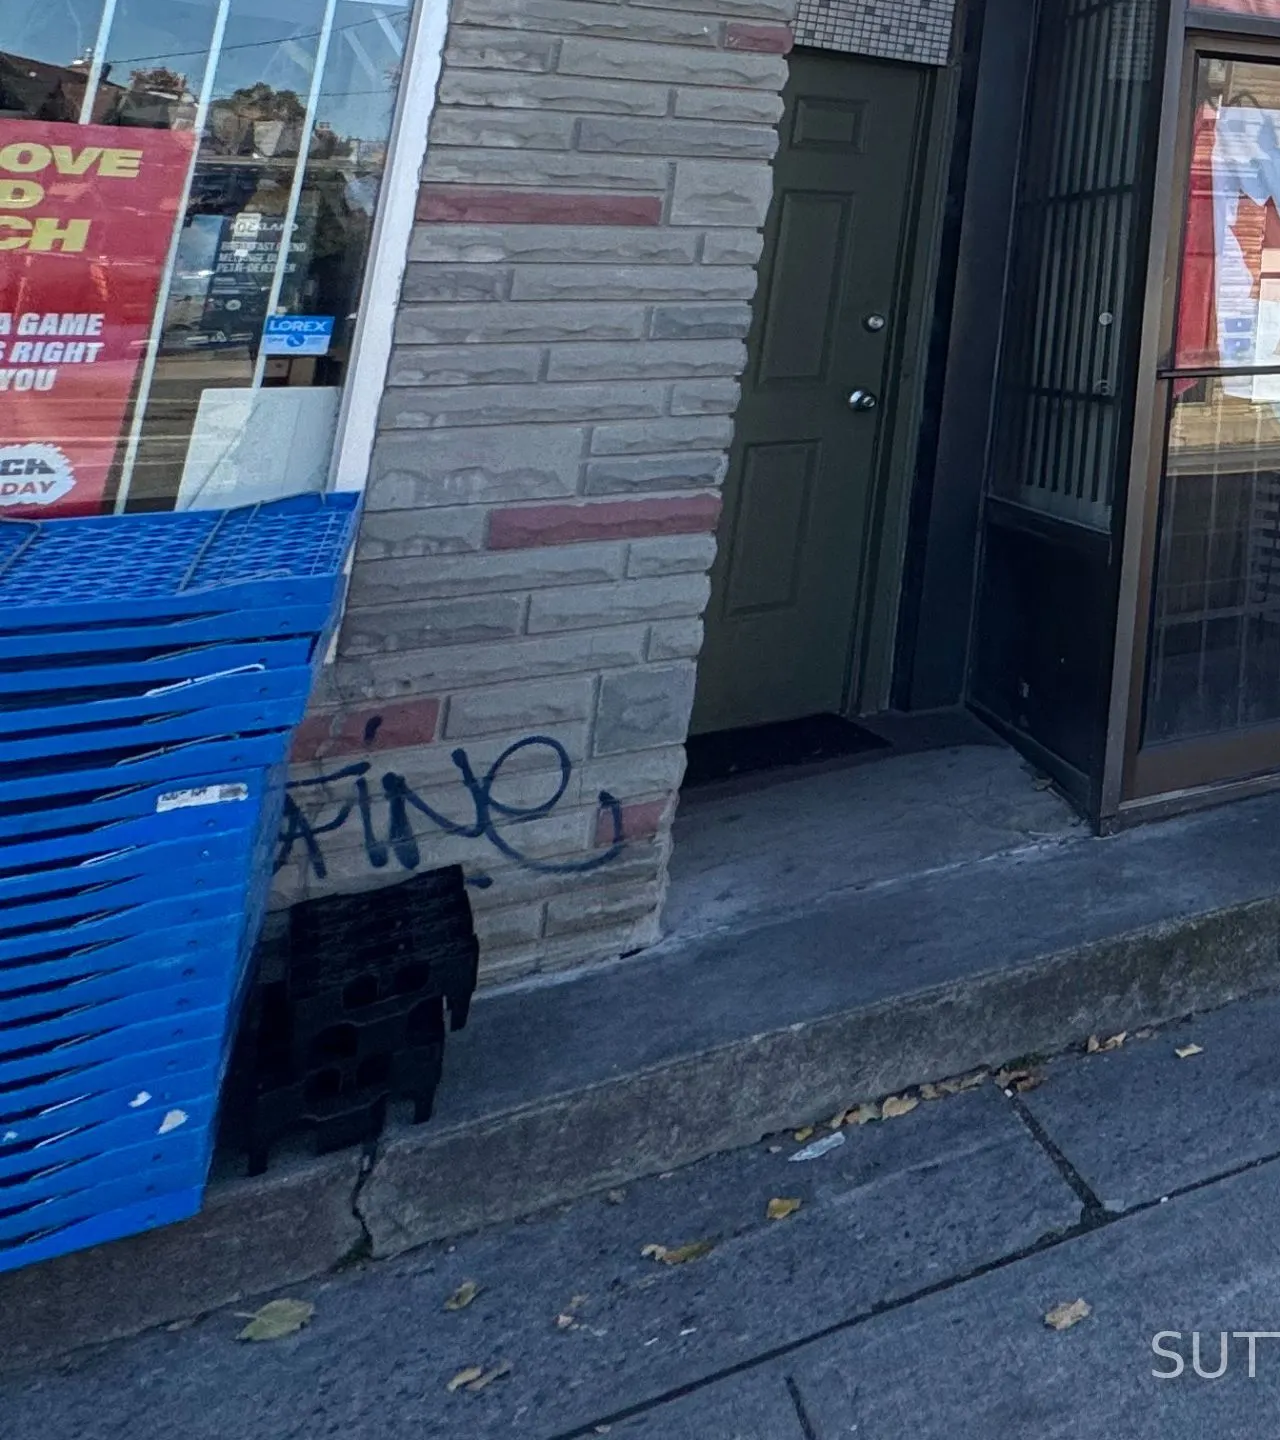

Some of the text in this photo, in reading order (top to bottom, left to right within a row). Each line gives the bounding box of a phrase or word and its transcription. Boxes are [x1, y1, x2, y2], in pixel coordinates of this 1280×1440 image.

[0, 142, 144, 178] OVE
[17, 313, 105, 336] GAME
[269, 320, 326, 332] LOREX
[9, 341, 105, 363] RIGHT
